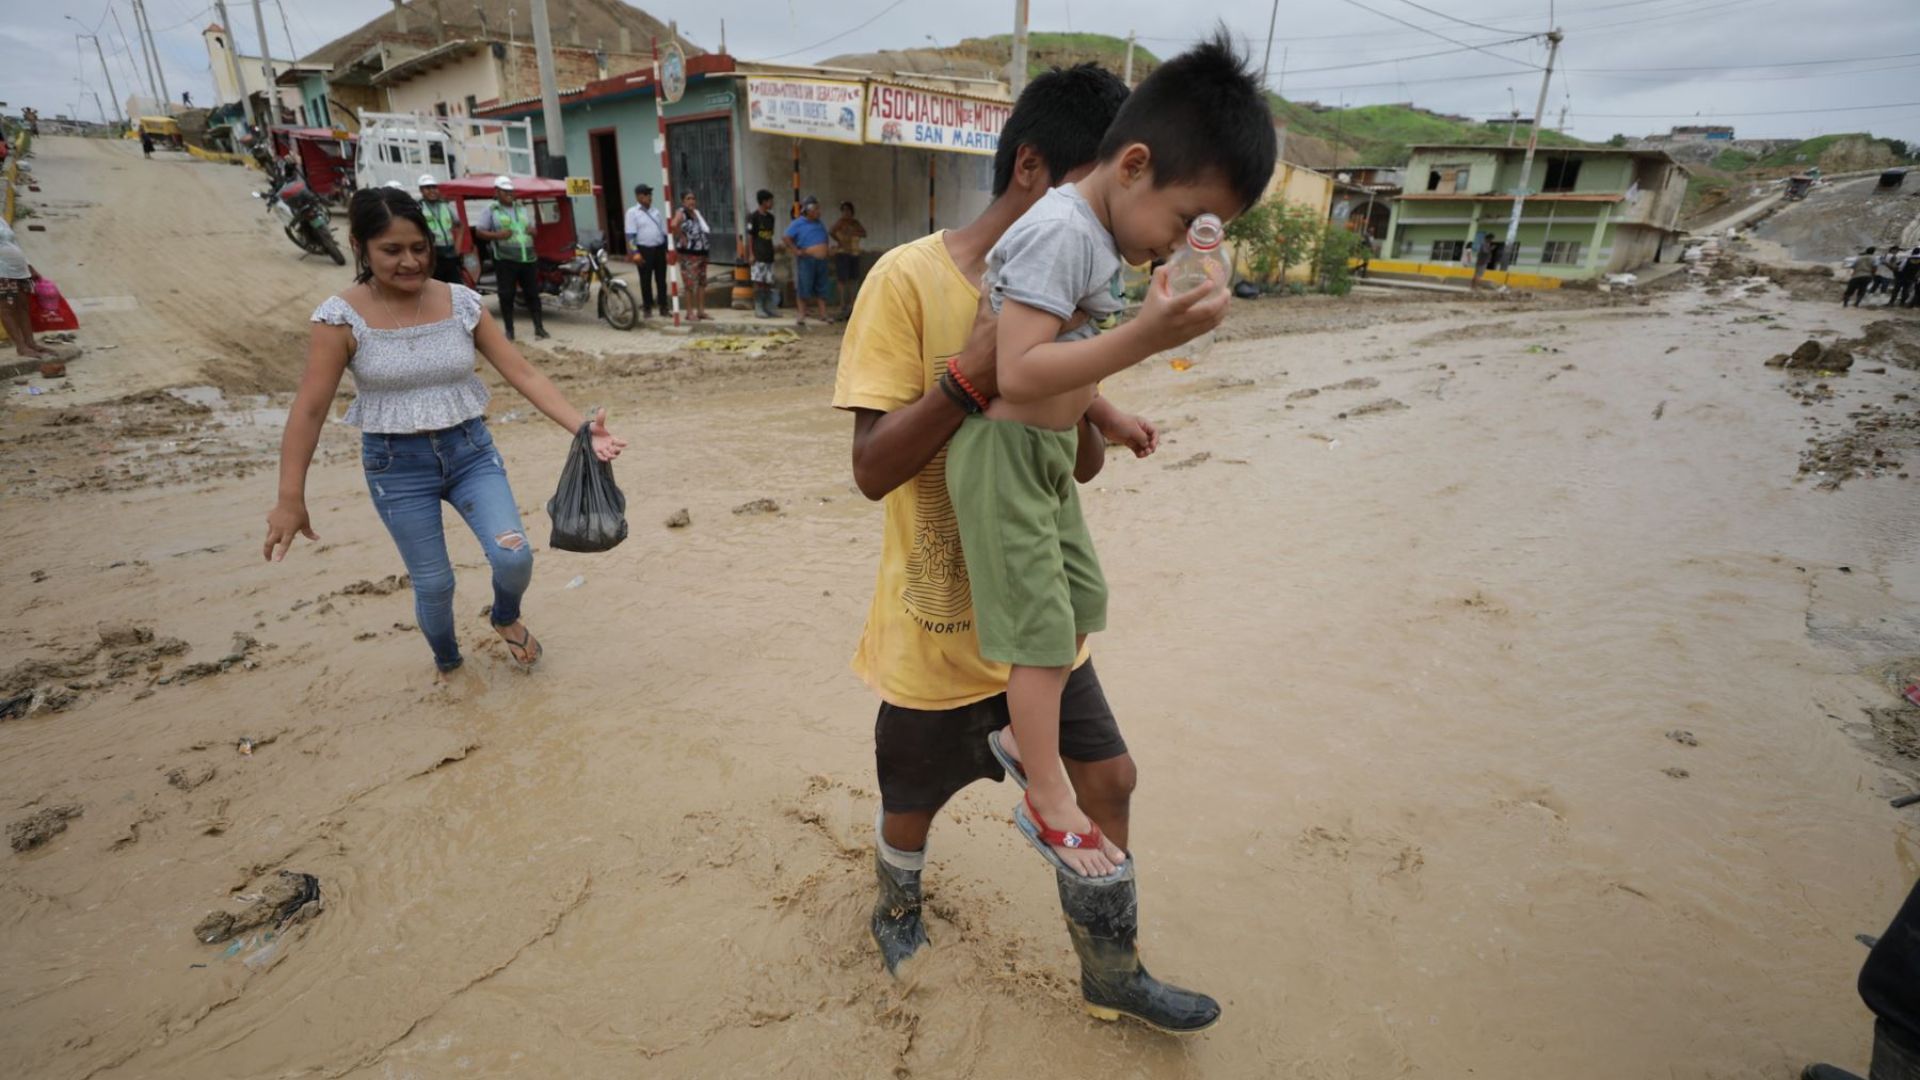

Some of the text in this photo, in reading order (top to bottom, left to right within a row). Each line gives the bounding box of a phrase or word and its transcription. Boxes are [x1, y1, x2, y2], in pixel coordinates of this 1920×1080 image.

[869, 86, 963, 128] ASOCIACION
[962, 108, 973, 124] DE
[915, 125, 943, 143] SAN
